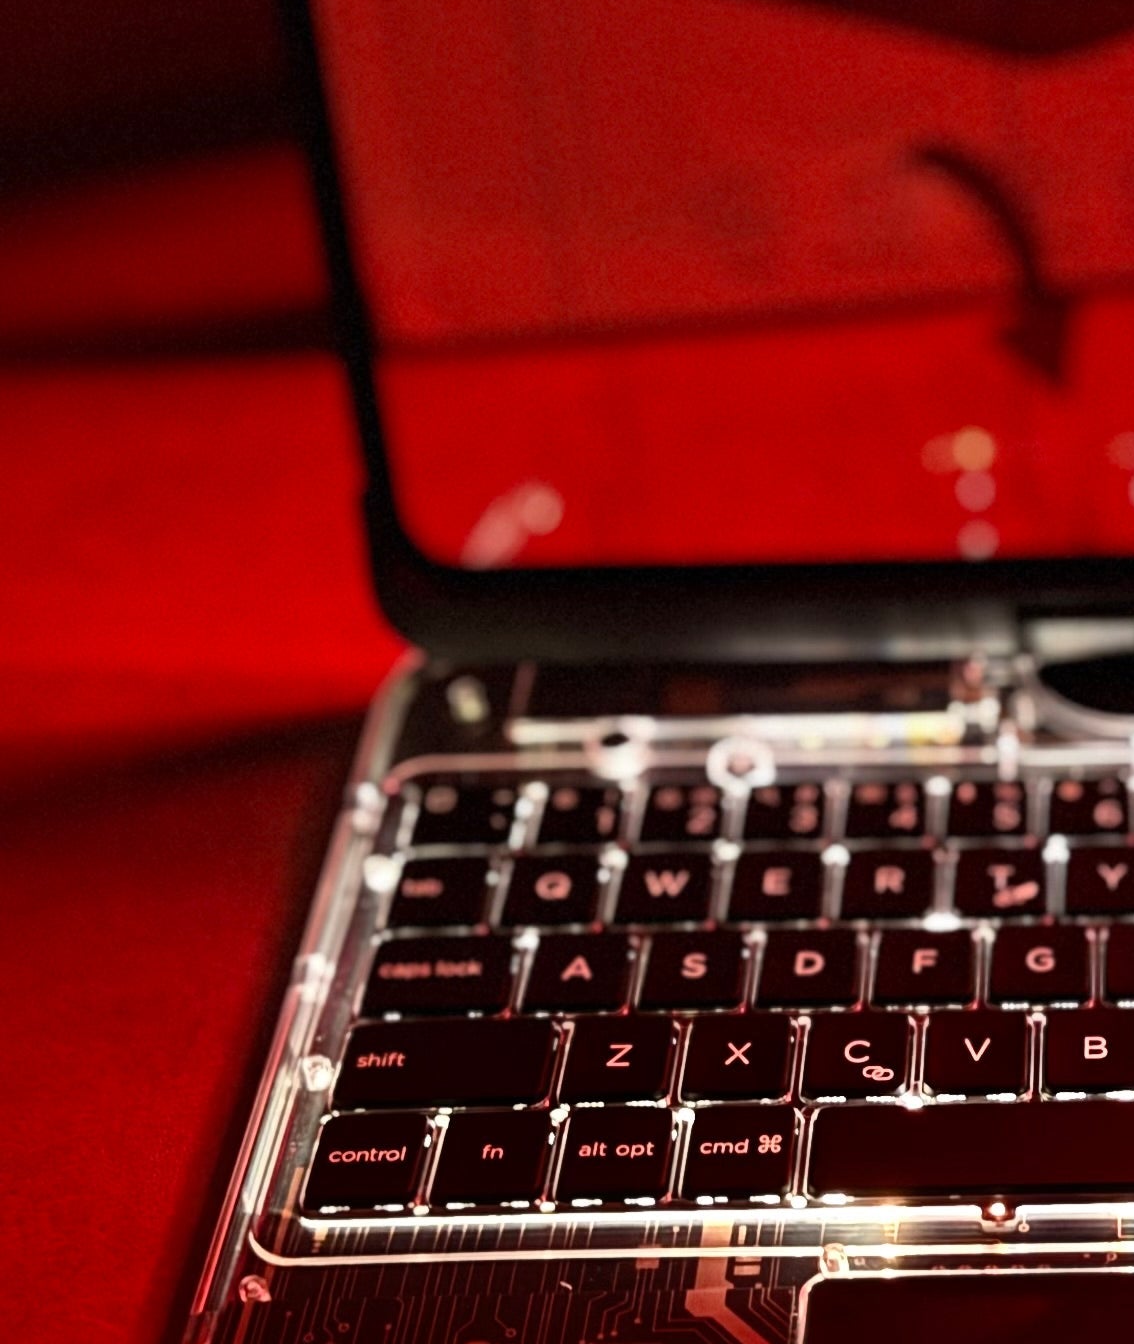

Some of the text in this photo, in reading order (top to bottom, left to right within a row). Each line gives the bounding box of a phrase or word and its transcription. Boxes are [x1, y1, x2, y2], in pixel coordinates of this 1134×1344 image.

[535, 872, 572, 900] Q
[645, 871, 689, 897] W
[762, 868, 789, 896] E
[874, 866, 905, 893] R
[1098, 863, 1127, 889] Y
[378, 960, 482, 980] caps lock
[561, 956, 592, 981] A
[681, 953, 707, 979] S
[794, 950, 825, 976] D
[912, 949, 938, 974] F
[1025, 946, 1055, 973] G
[356, 1052, 406, 1068] shift
[605, 1043, 633, 1067] Z
[724, 1042, 752, 1066] X
[844, 1039, 871, 1064] C
[964, 1037, 991, 1062] V
[1083, 1035, 1109, 1060] B
[328, 1145, 407, 1163] control
[482, 1144, 504, 1160] fn
[578, 1141, 655, 1159] alt opt
[699, 1138, 750, 1155] cmd
